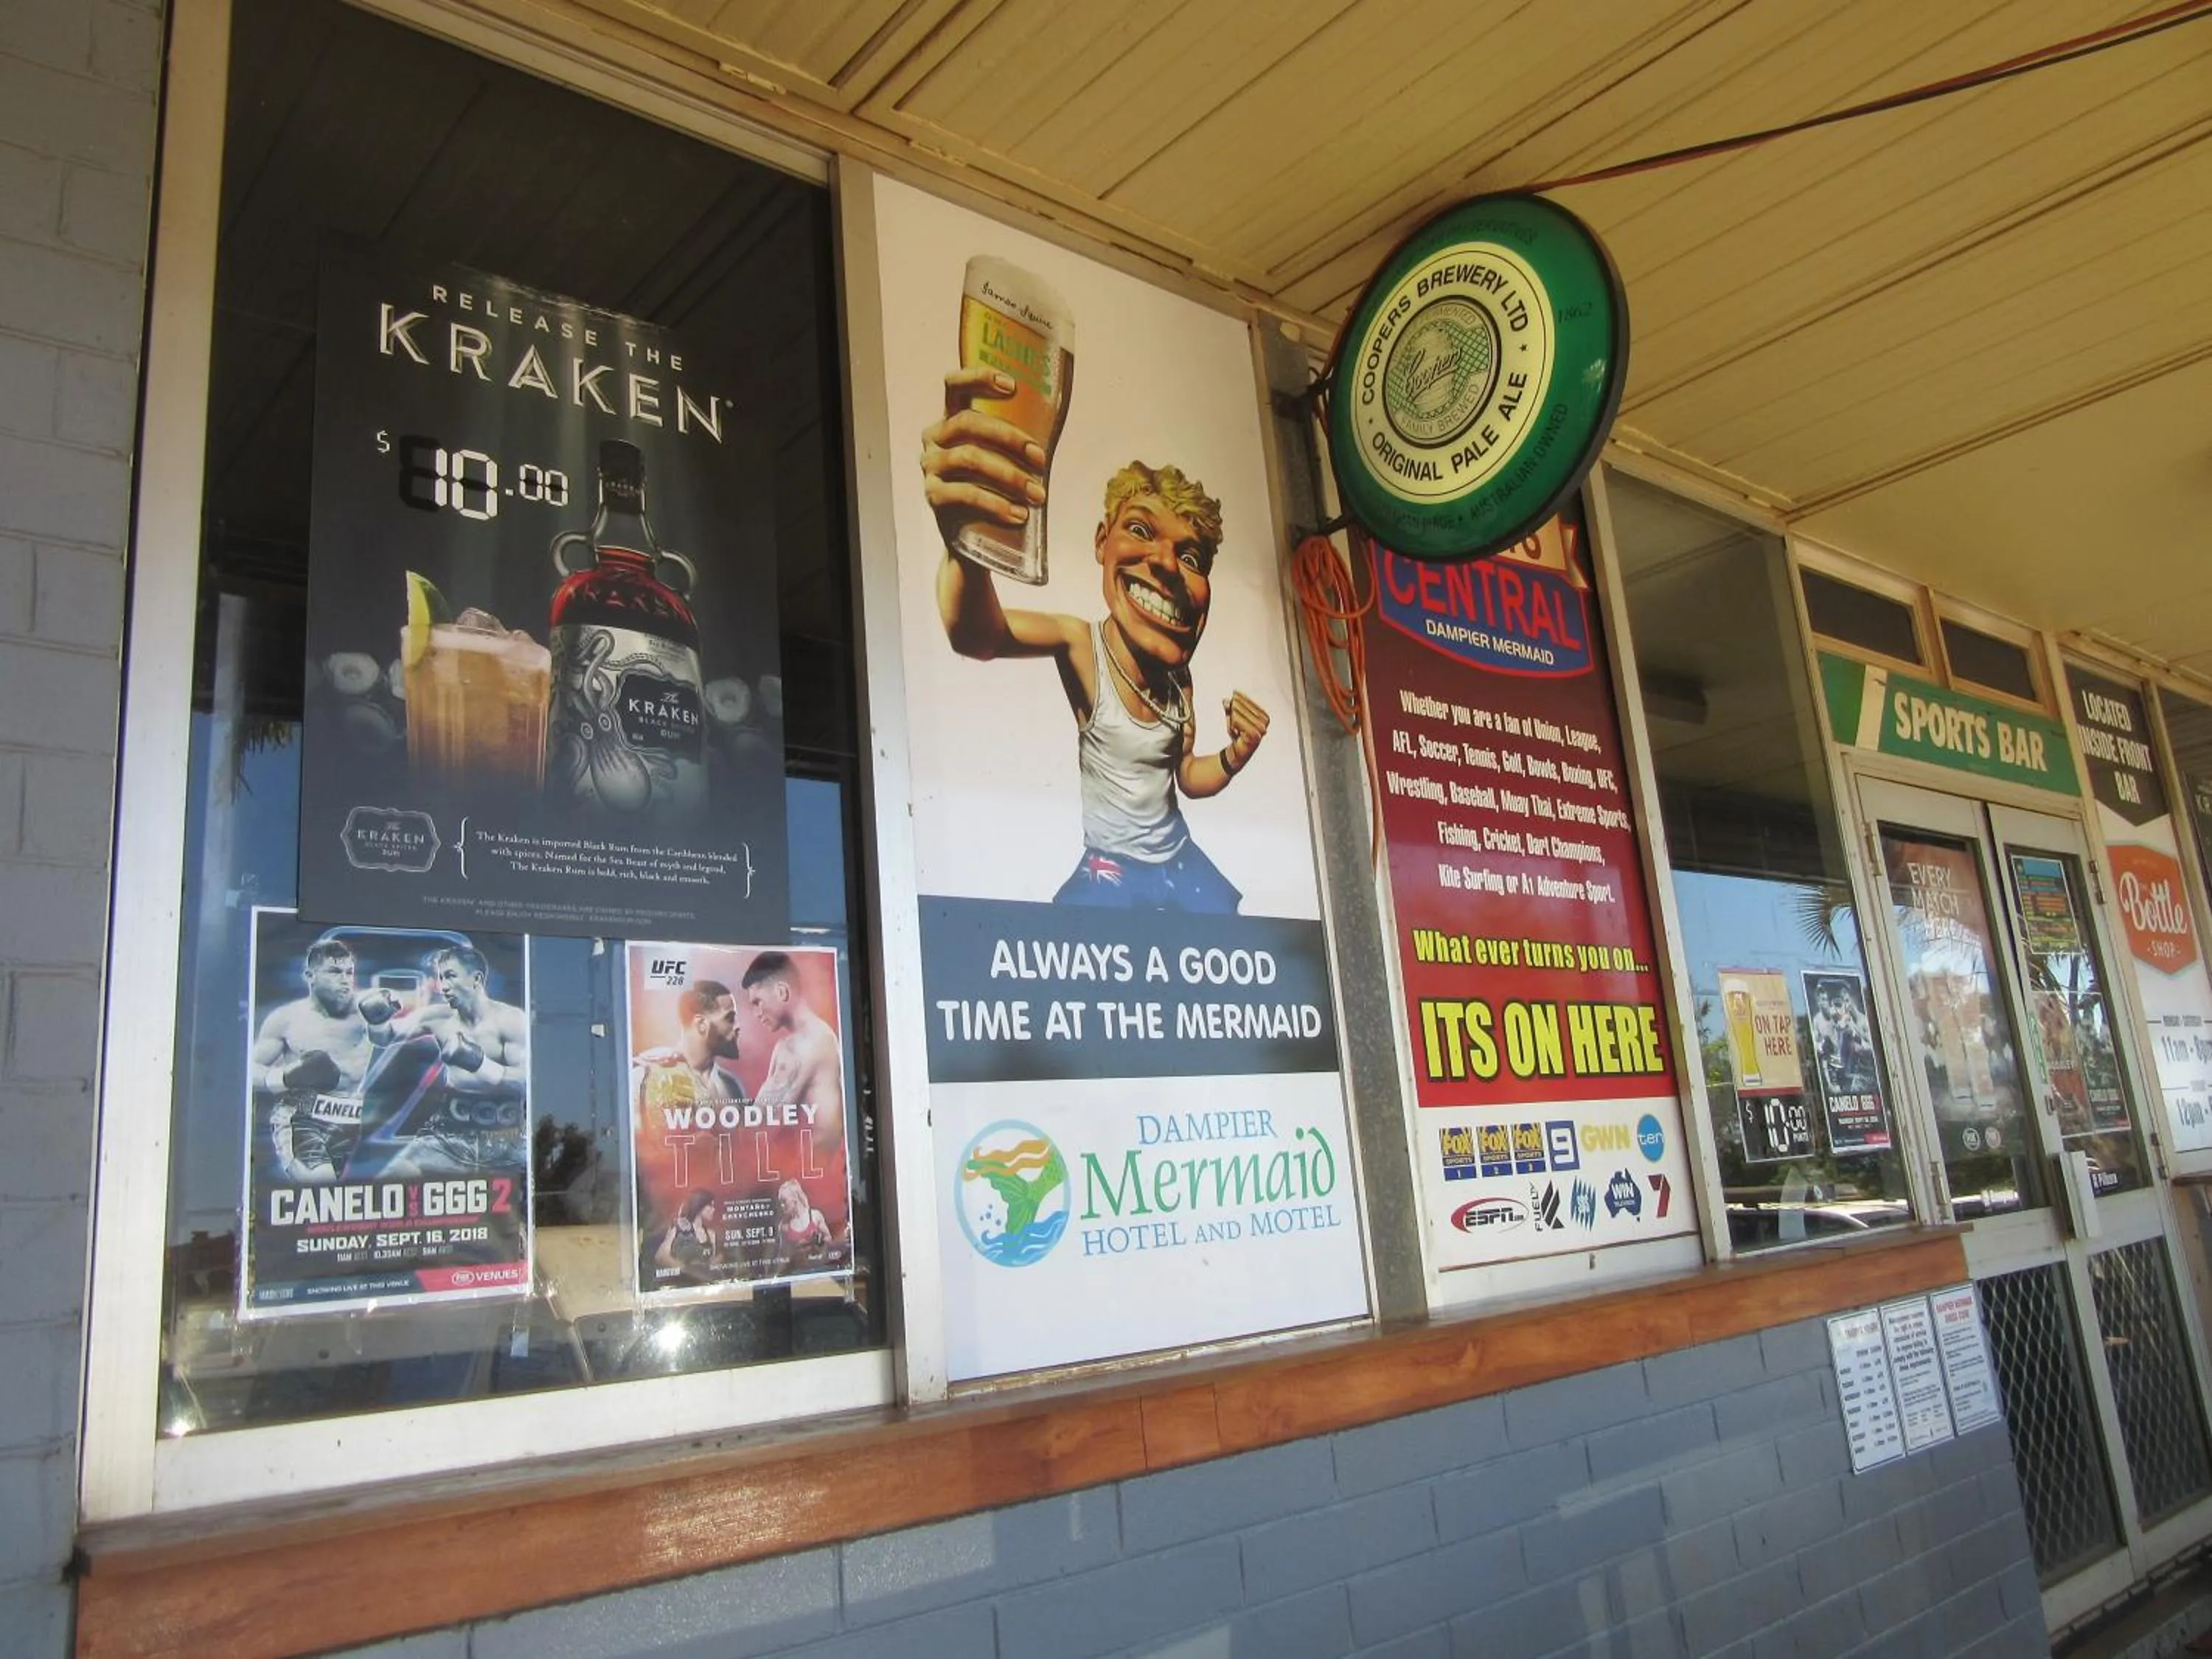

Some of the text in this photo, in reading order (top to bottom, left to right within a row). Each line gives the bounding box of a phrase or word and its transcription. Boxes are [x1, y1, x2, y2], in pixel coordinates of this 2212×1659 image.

[432, 285, 684, 372] RELEASE THE
[1362, 263, 1528, 405] COOPERS BREWERY LTD
[378, 302, 723, 444] KRAKEN
[1372, 371, 1528, 481] ORIGINAL PALE ALE
[1438, 383, 1481, 434] BREWED
[1384, 549, 1582, 651] CENTRAL
[1425, 618, 1555, 666] DAMPIER MERMAID
[629, 699, 698, 726] KRAKEN
[1400, 689, 1601, 754] Whether you are a fan of Union, League,
[1893, 691, 2049, 773] SPORTS BAR
[2081, 689, 2132, 732] LOCATED
[1392, 730, 1618, 795] AFL, Soccer, Tennis, Golf, Bowls, Boxing, UFC,
[2077, 725, 2120, 765] INSIDE
[1386, 771, 1632, 833] Wrestling, Baseball, Muay Thai, Extreme Sports,
[2114, 771, 2141, 804] BAR
[358, 830, 425, 844] KRAKEN
[476, 831, 495, 841] The
[498, 832, 530, 844] Kraken
[542, 838, 582, 849] imported
[490, 847, 512, 856] with
[545, 850, 577, 861] Named
[579, 853, 591, 862] for
[594, 854, 607, 863] the
[1438, 821, 1606, 867] Fishing, Cricket, Dart Champions,
[509, 860, 529, 871] The
[532, 863, 563, 874] Kraken
[1439, 863, 1461, 888] Kite
[1463, 866, 1504, 897] Surfing
[1506, 876, 1519, 894] or
[1537, 874, 1586, 900] Adventure
[1586, 879, 1616, 905] Sport.
[1906, 862, 1952, 890] EVERY
[1910, 886, 1960, 917] MATCH
[2118, 871, 2188, 935] Bottle
[651, 960, 686, 975] UFC
[990, 939, 1277, 986] ALWAYS A GOOD
[1413, 929, 1473, 964] What
[1475, 937, 1520, 967] ever
[1523, 937, 1575, 969] turns
[1576, 943, 1611, 973] you
[936, 999, 1322, 1041] TIME AT THE MERMAID
[1419, 1001, 1664, 1079] ITS ON HERE
[1753, 1014, 1792, 1034] ON TAP
[1763, 1037, 1793, 1057] HERE
[664, 1103, 819, 1131] WOODLEY
[1136, 1108, 1279, 1146] DAMPIER
[1580, 1123, 1631, 1153] GWN
[664, 1129, 824, 1188] TILL
[1079, 1125, 1337, 1221] Mermaid
[271, 1183, 405, 1227] CANELO
[422, 1179, 488, 1217] GGG
[491, 1177, 512, 1214] 2
[1612, 1182, 1635, 1200] WIN
[376, 1228, 423, 1248] SEPT.
[449, 1225, 488, 1243] 2018
[1082, 1204, 1342, 1257] HOTEL AND MOTEL
[1464, 1206, 1514, 1227] ESPN
